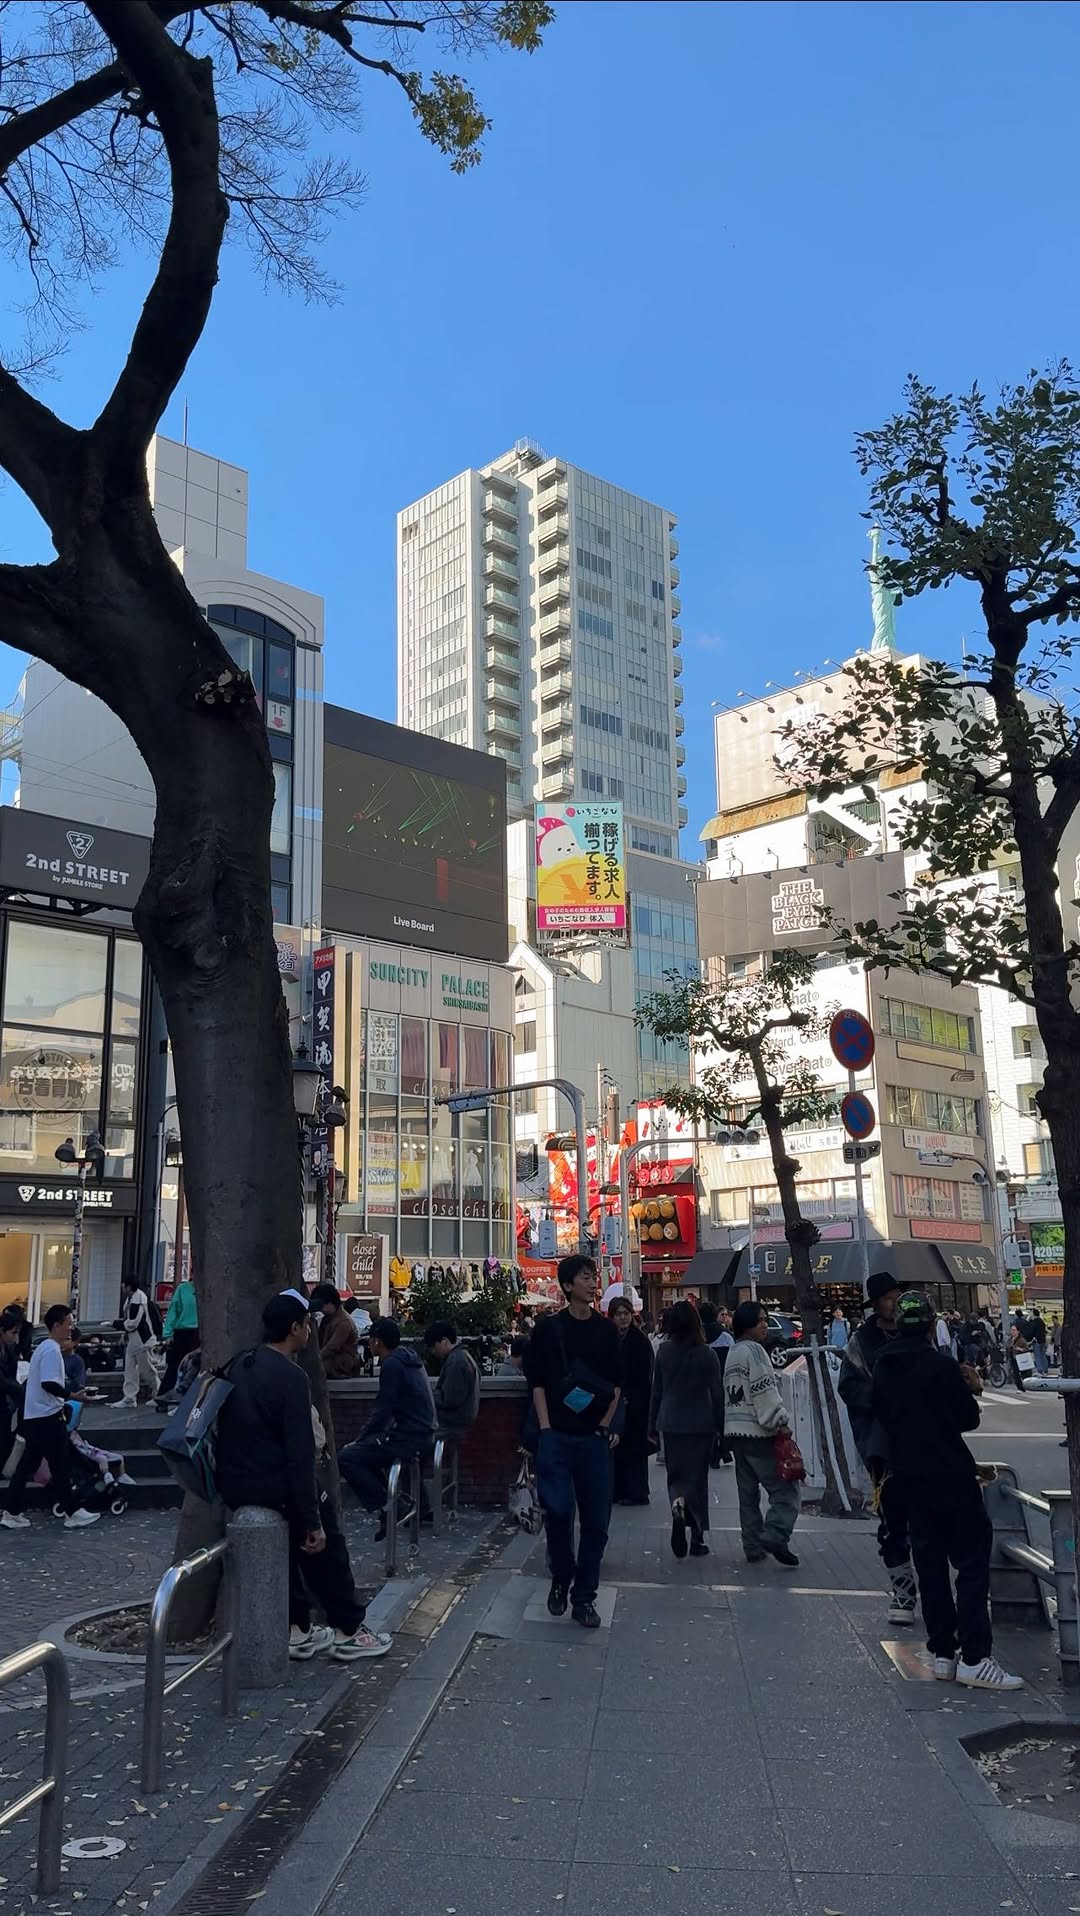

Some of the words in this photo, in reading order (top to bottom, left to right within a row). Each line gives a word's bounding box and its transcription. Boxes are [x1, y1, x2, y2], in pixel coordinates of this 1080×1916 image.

[584, 822, 601, 901] 揃ってます。
[602, 822, 620, 900] 稼げる求人
[25, 853, 61, 873] 2nd
[65, 861, 130, 885] STREET
[52, 874, 61, 883] by
[84, 881, 104, 890] STORE
[782, 881, 811, 896] THE
[774, 892, 823, 909] BLACK
[784, 905, 811, 918] EYE
[393, 915, 410, 928] Live
[410, 919, 435, 933] Board
[776, 916, 821, 931] PATCH
[370, 961, 429, 989] SUNCITY
[441, 974, 490, 999] PALACE
[37, 1188, 64, 1201] 2nd
[352, 1240, 377, 1255] closet
[1034, 1246, 1053, 1258] 420
[351, 1256, 377, 1271] child
